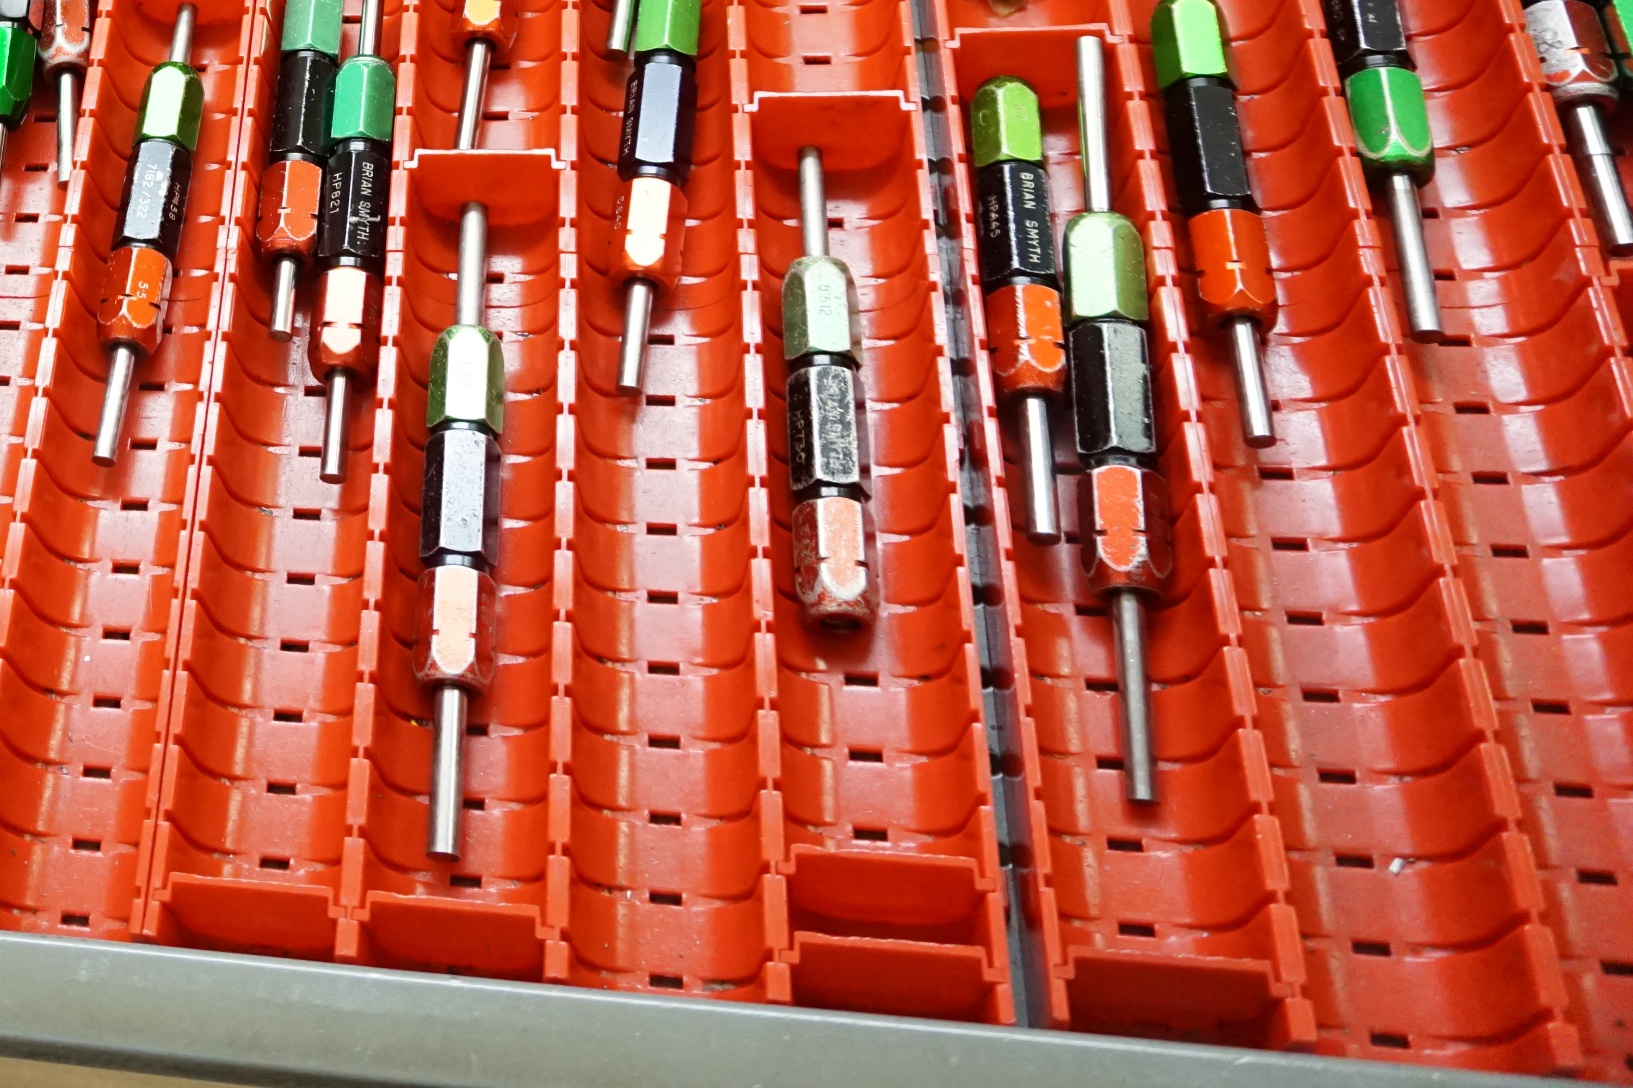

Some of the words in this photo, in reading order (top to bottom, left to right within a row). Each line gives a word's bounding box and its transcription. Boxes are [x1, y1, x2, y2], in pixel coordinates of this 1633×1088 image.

[627, 78, 638, 114] BRIAN
[622, 116, 634, 156] SMYTH
[329, 171, 344, 215] HP821
[359, 161, 375, 197] BRIAN
[1019, 171, 1037, 210] BRIAN
[1023, 217, 1041, 264] SMYTH
